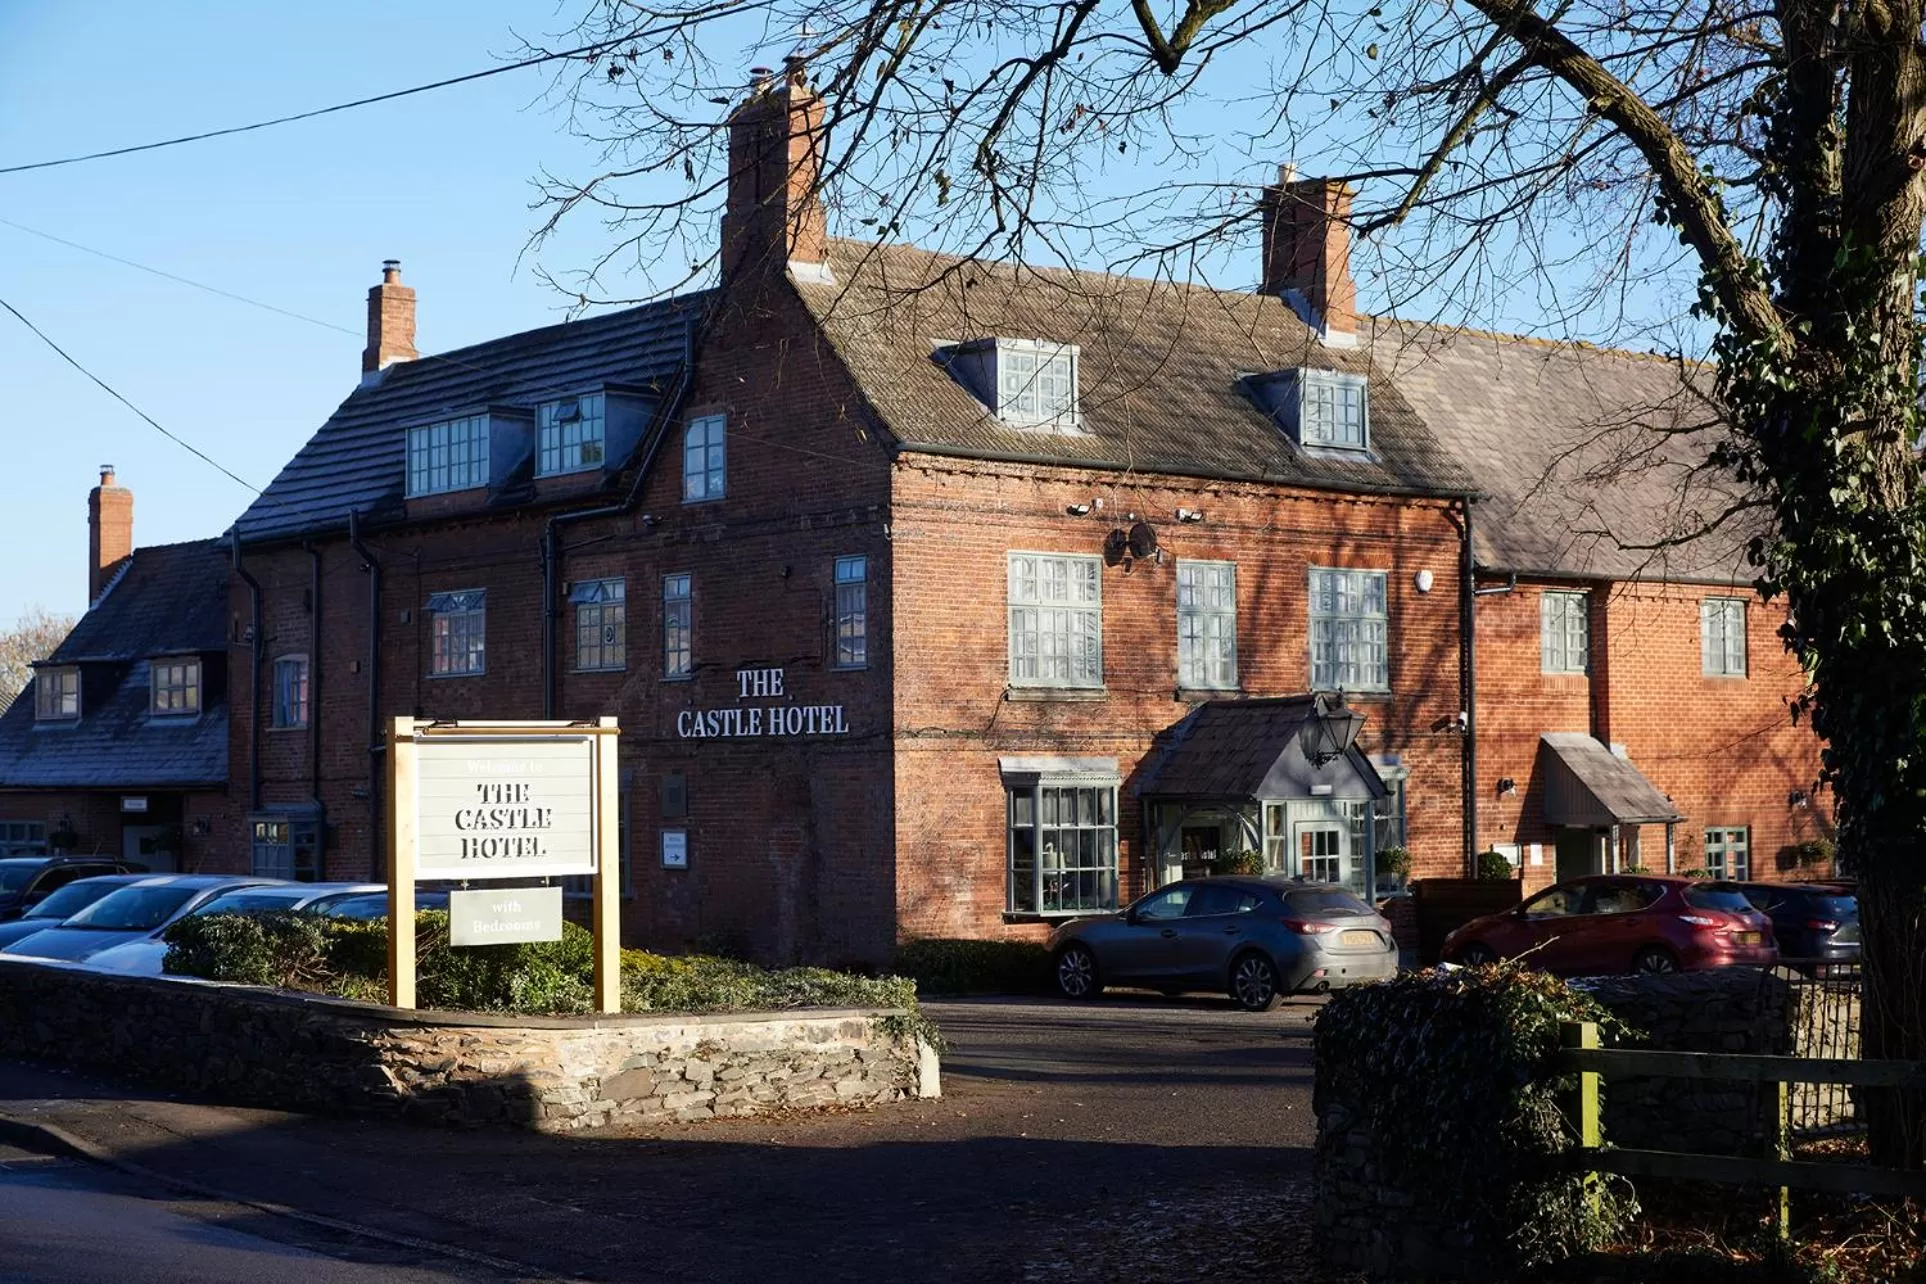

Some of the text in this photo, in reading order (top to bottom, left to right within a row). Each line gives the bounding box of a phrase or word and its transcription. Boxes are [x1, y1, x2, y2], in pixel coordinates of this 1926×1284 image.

[737, 668, 784, 698] THE
[677, 705, 849, 738] CASTLE HOTEL
[476, 783, 530, 804] THE
[455, 808, 552, 830] CASTLE
[461, 837, 547, 859] HOTEL
[492, 900, 522, 913] with
